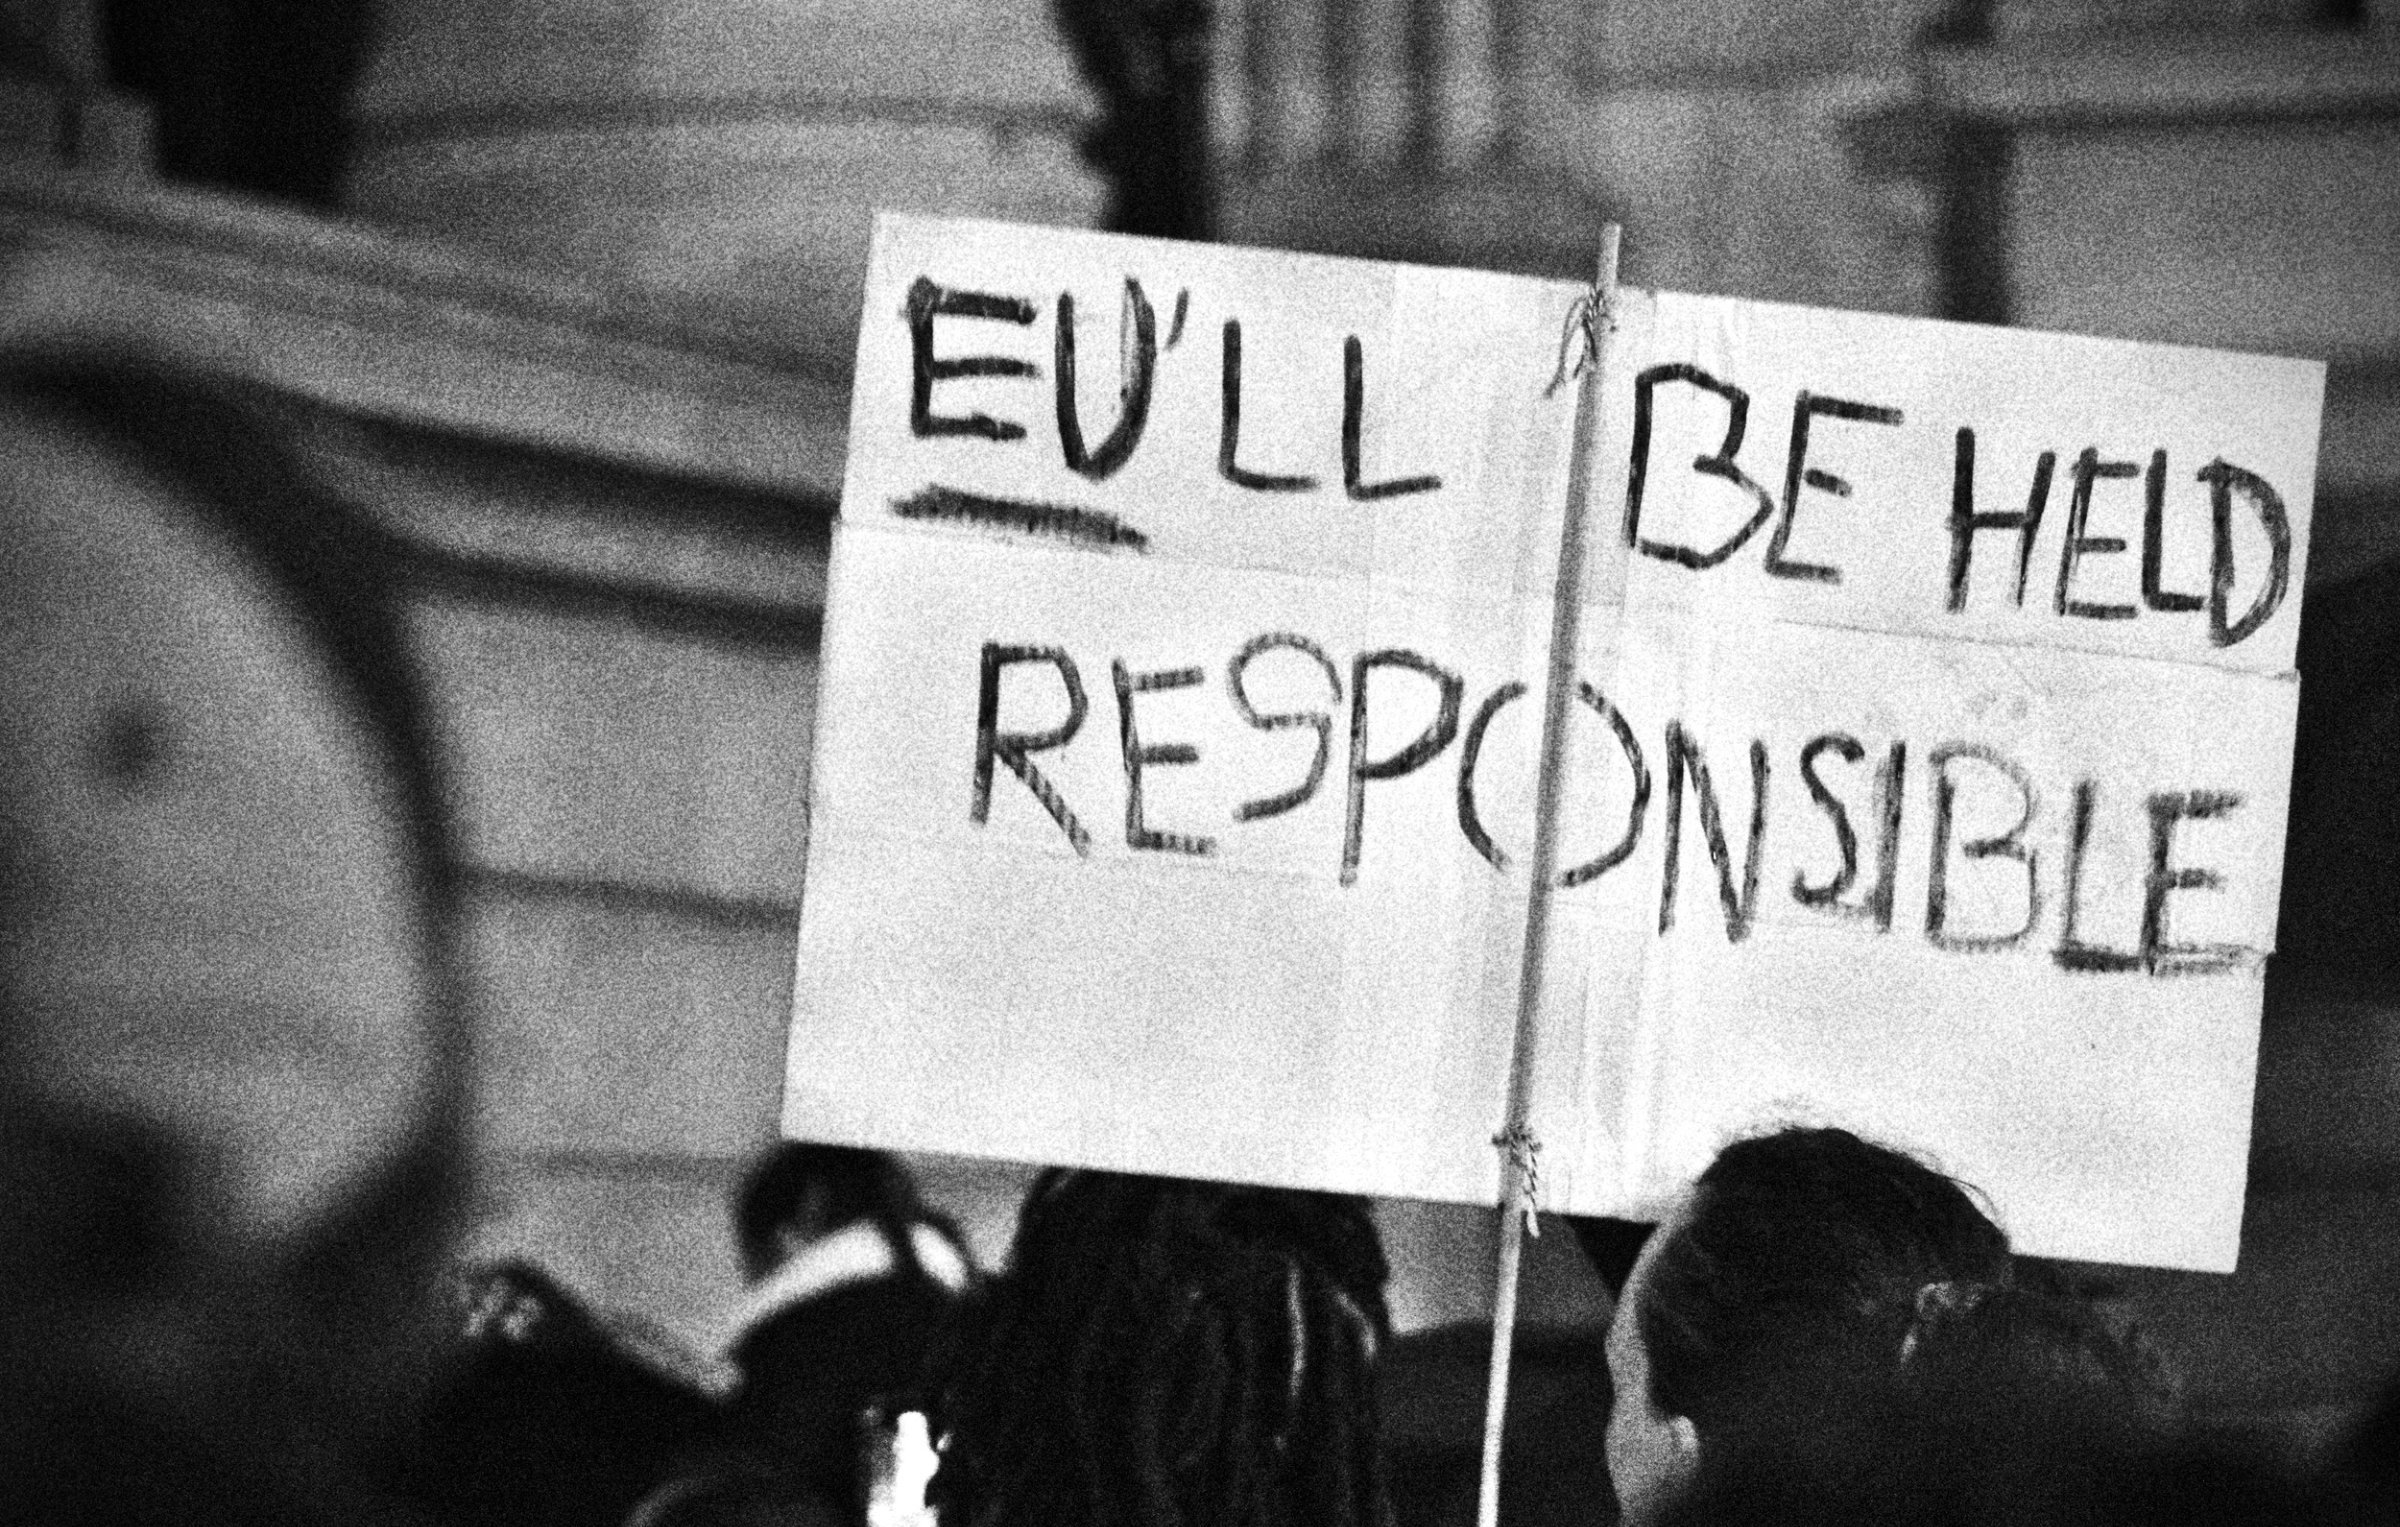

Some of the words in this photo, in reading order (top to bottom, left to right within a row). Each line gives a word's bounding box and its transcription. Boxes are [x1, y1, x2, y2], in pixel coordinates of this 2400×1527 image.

[904, 275, 1443, 500] EU'LL
[1625, 362, 1904, 585] BE
[1947, 426, 2292, 647] HELD
[970, 632, 2254, 976] RESPONSIBLE
